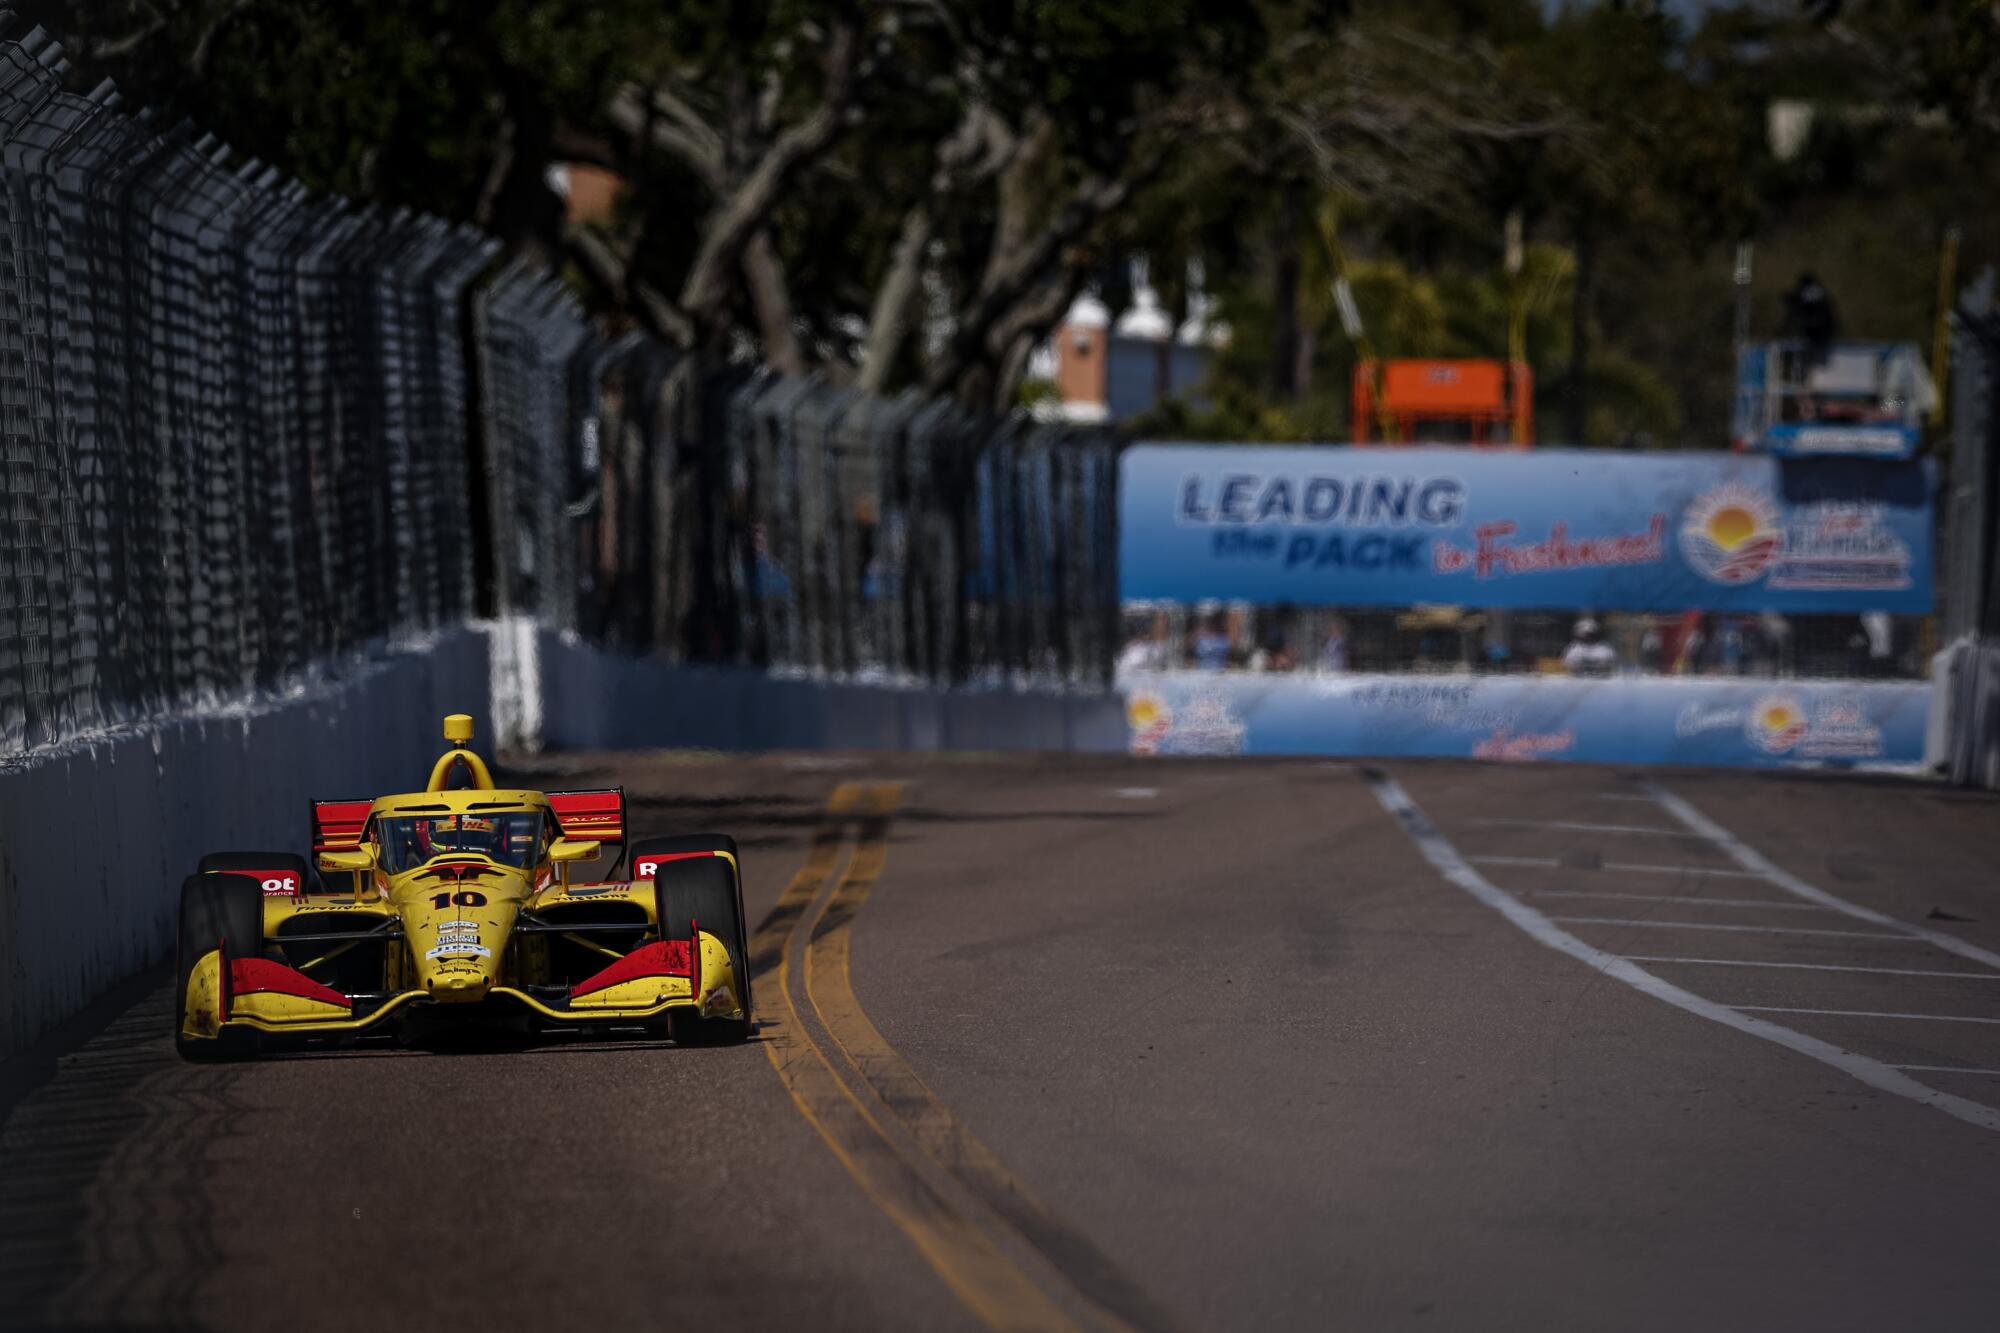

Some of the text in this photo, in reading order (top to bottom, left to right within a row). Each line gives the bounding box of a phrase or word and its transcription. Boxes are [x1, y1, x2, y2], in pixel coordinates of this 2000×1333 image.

[1179, 471, 1466, 527] LEADING
[1286, 532, 1427, 570] PACK
[639, 862, 658, 876] R
[261, 877, 295, 891] ot
[429, 891, 488, 910] 10
